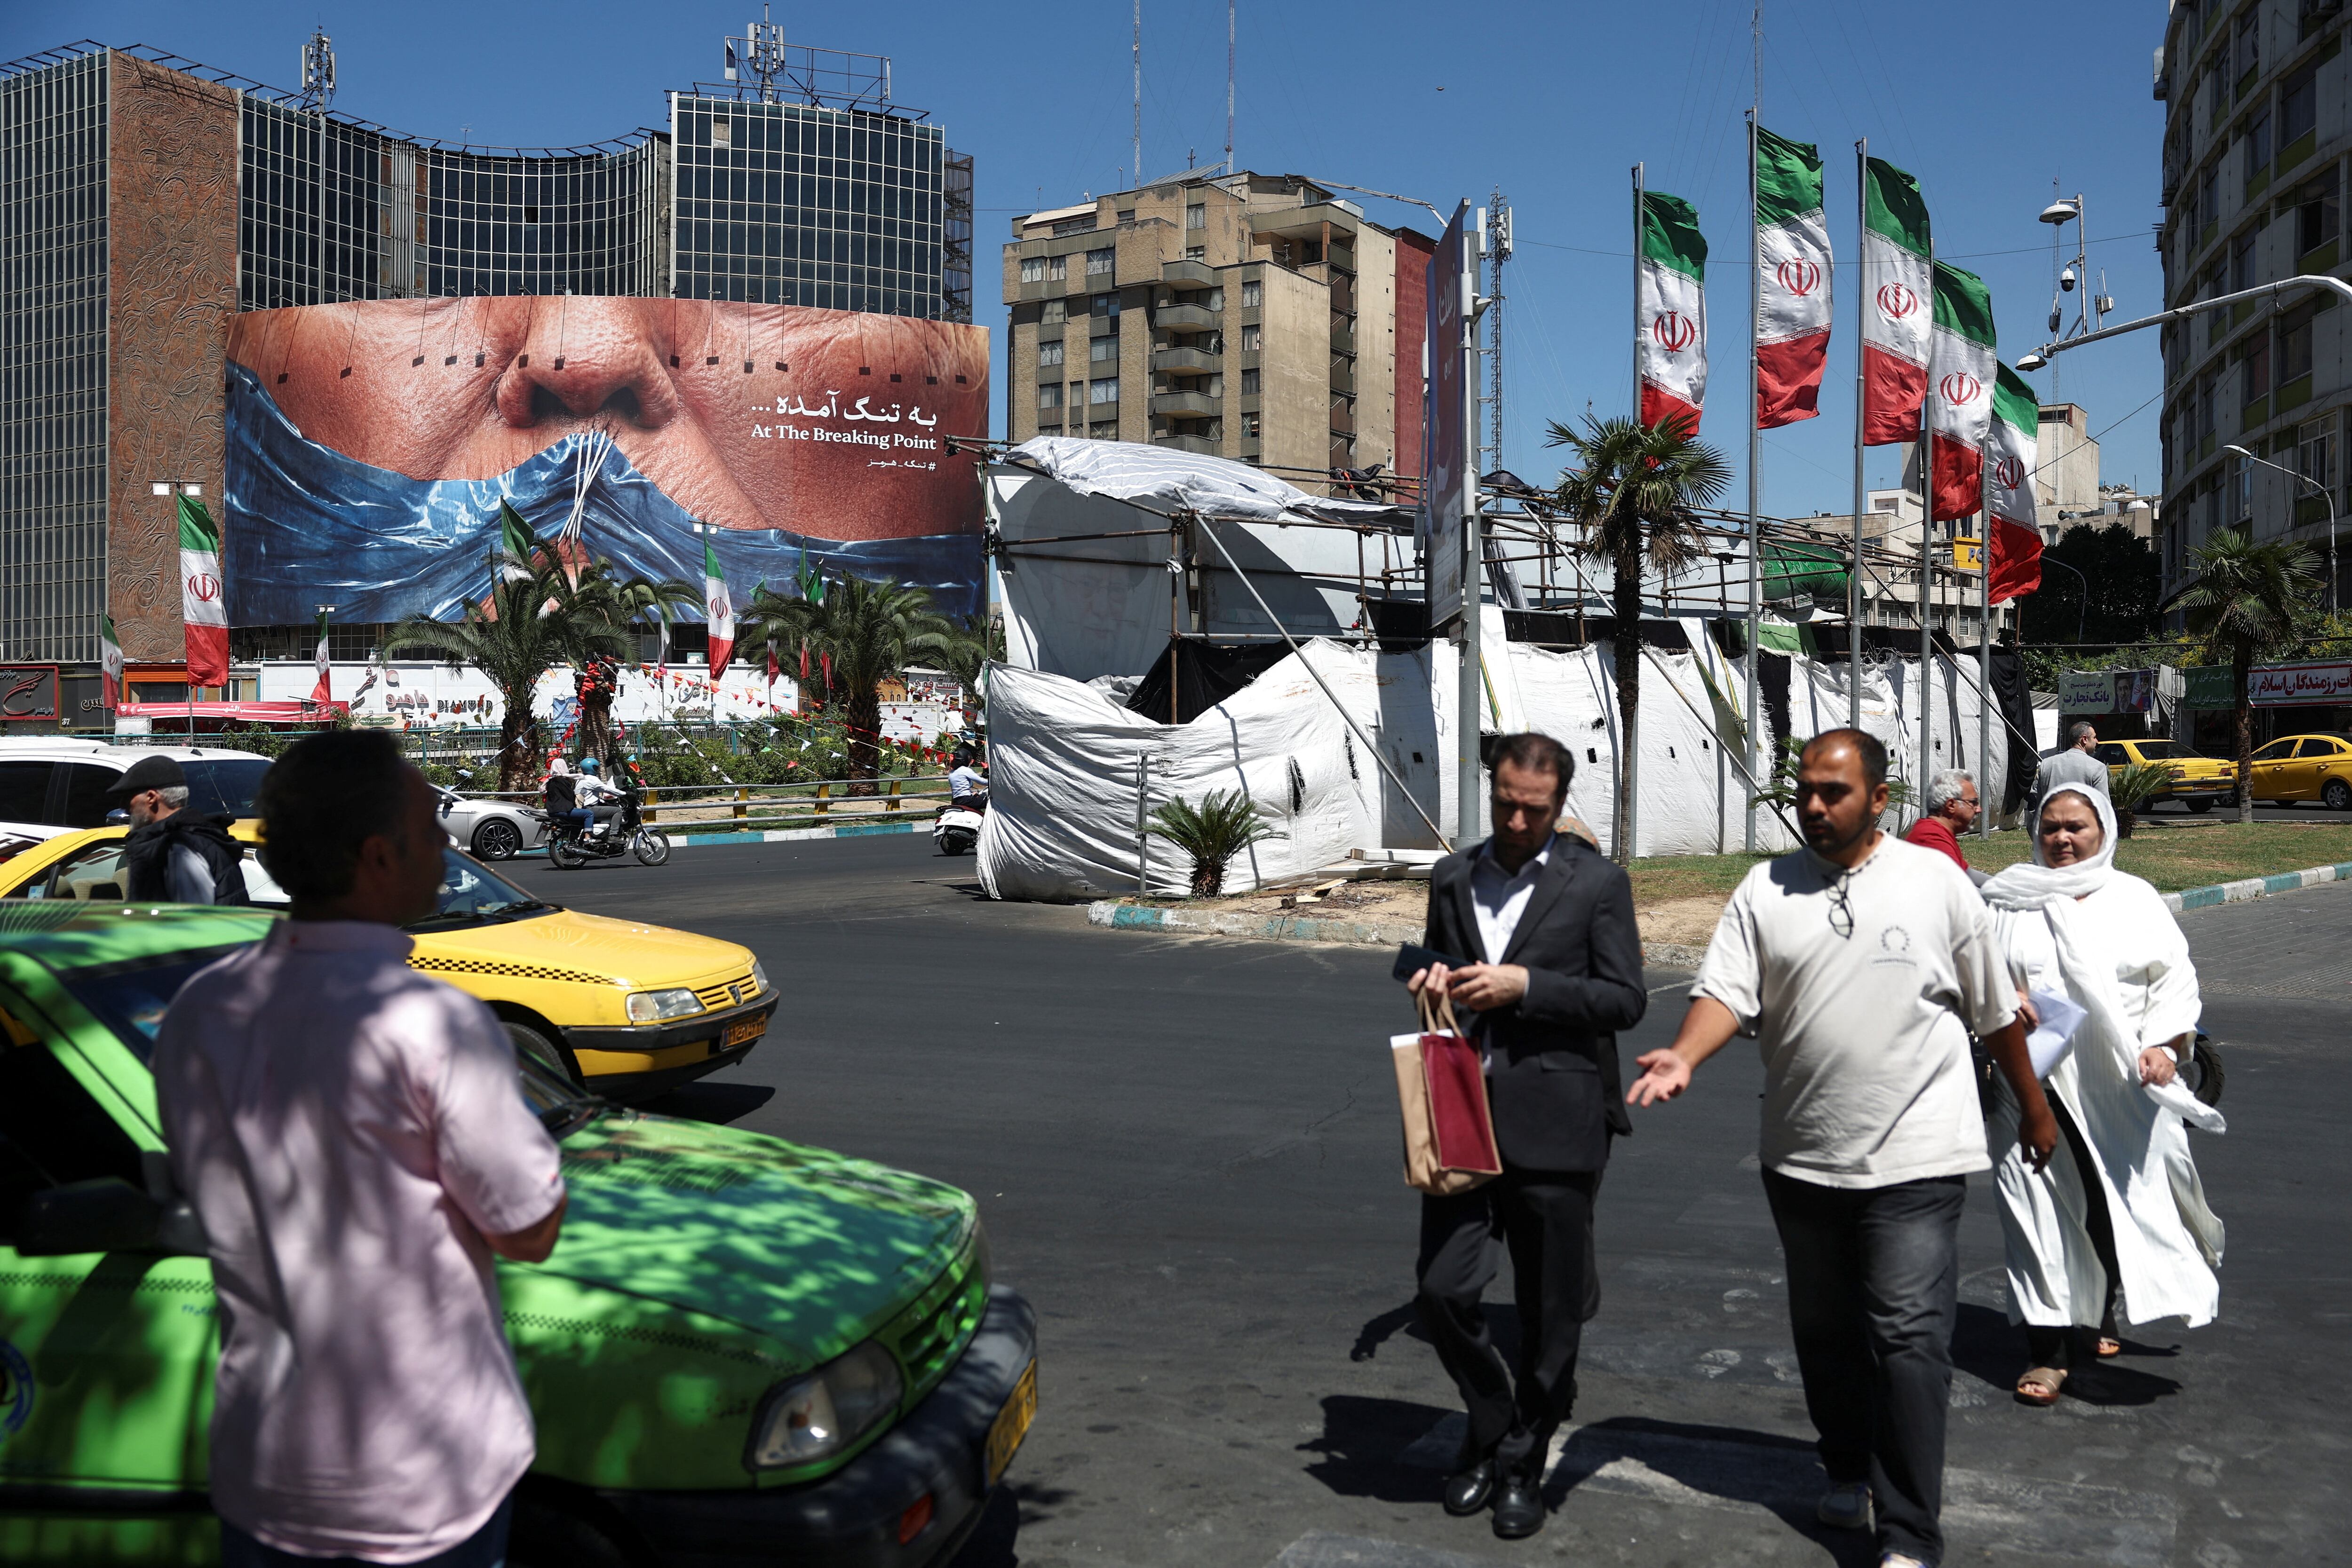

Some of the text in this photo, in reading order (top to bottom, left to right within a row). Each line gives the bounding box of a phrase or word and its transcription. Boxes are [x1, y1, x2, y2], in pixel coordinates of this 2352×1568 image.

[844, 396, 900, 422] تنگ
[908, 406, 937, 432] به
[751, 424, 937, 450] At The Breaking Point
[2258, 673, 2287, 697] اسلام
[2285, 673, 2337, 696] رزمندگان
[2063, 690, 2110, 706] بانک تجارت
